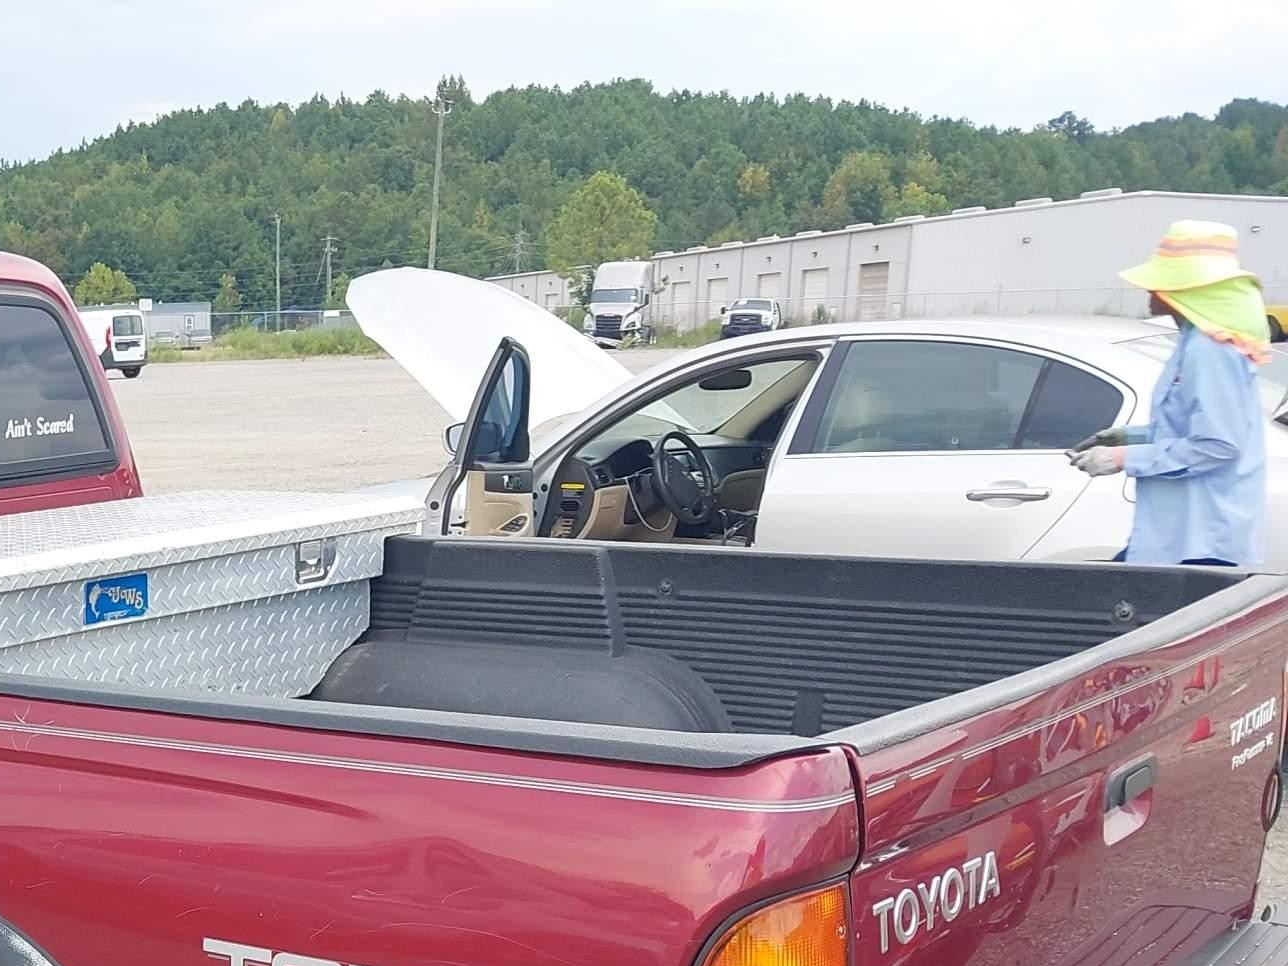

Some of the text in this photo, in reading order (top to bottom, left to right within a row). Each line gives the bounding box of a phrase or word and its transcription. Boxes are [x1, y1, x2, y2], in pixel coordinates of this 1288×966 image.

[5, 413, 74, 439] Ain't Scared
[1230, 696, 1277, 746] TACOMA
[872, 851, 1000, 954] TOYOTA
